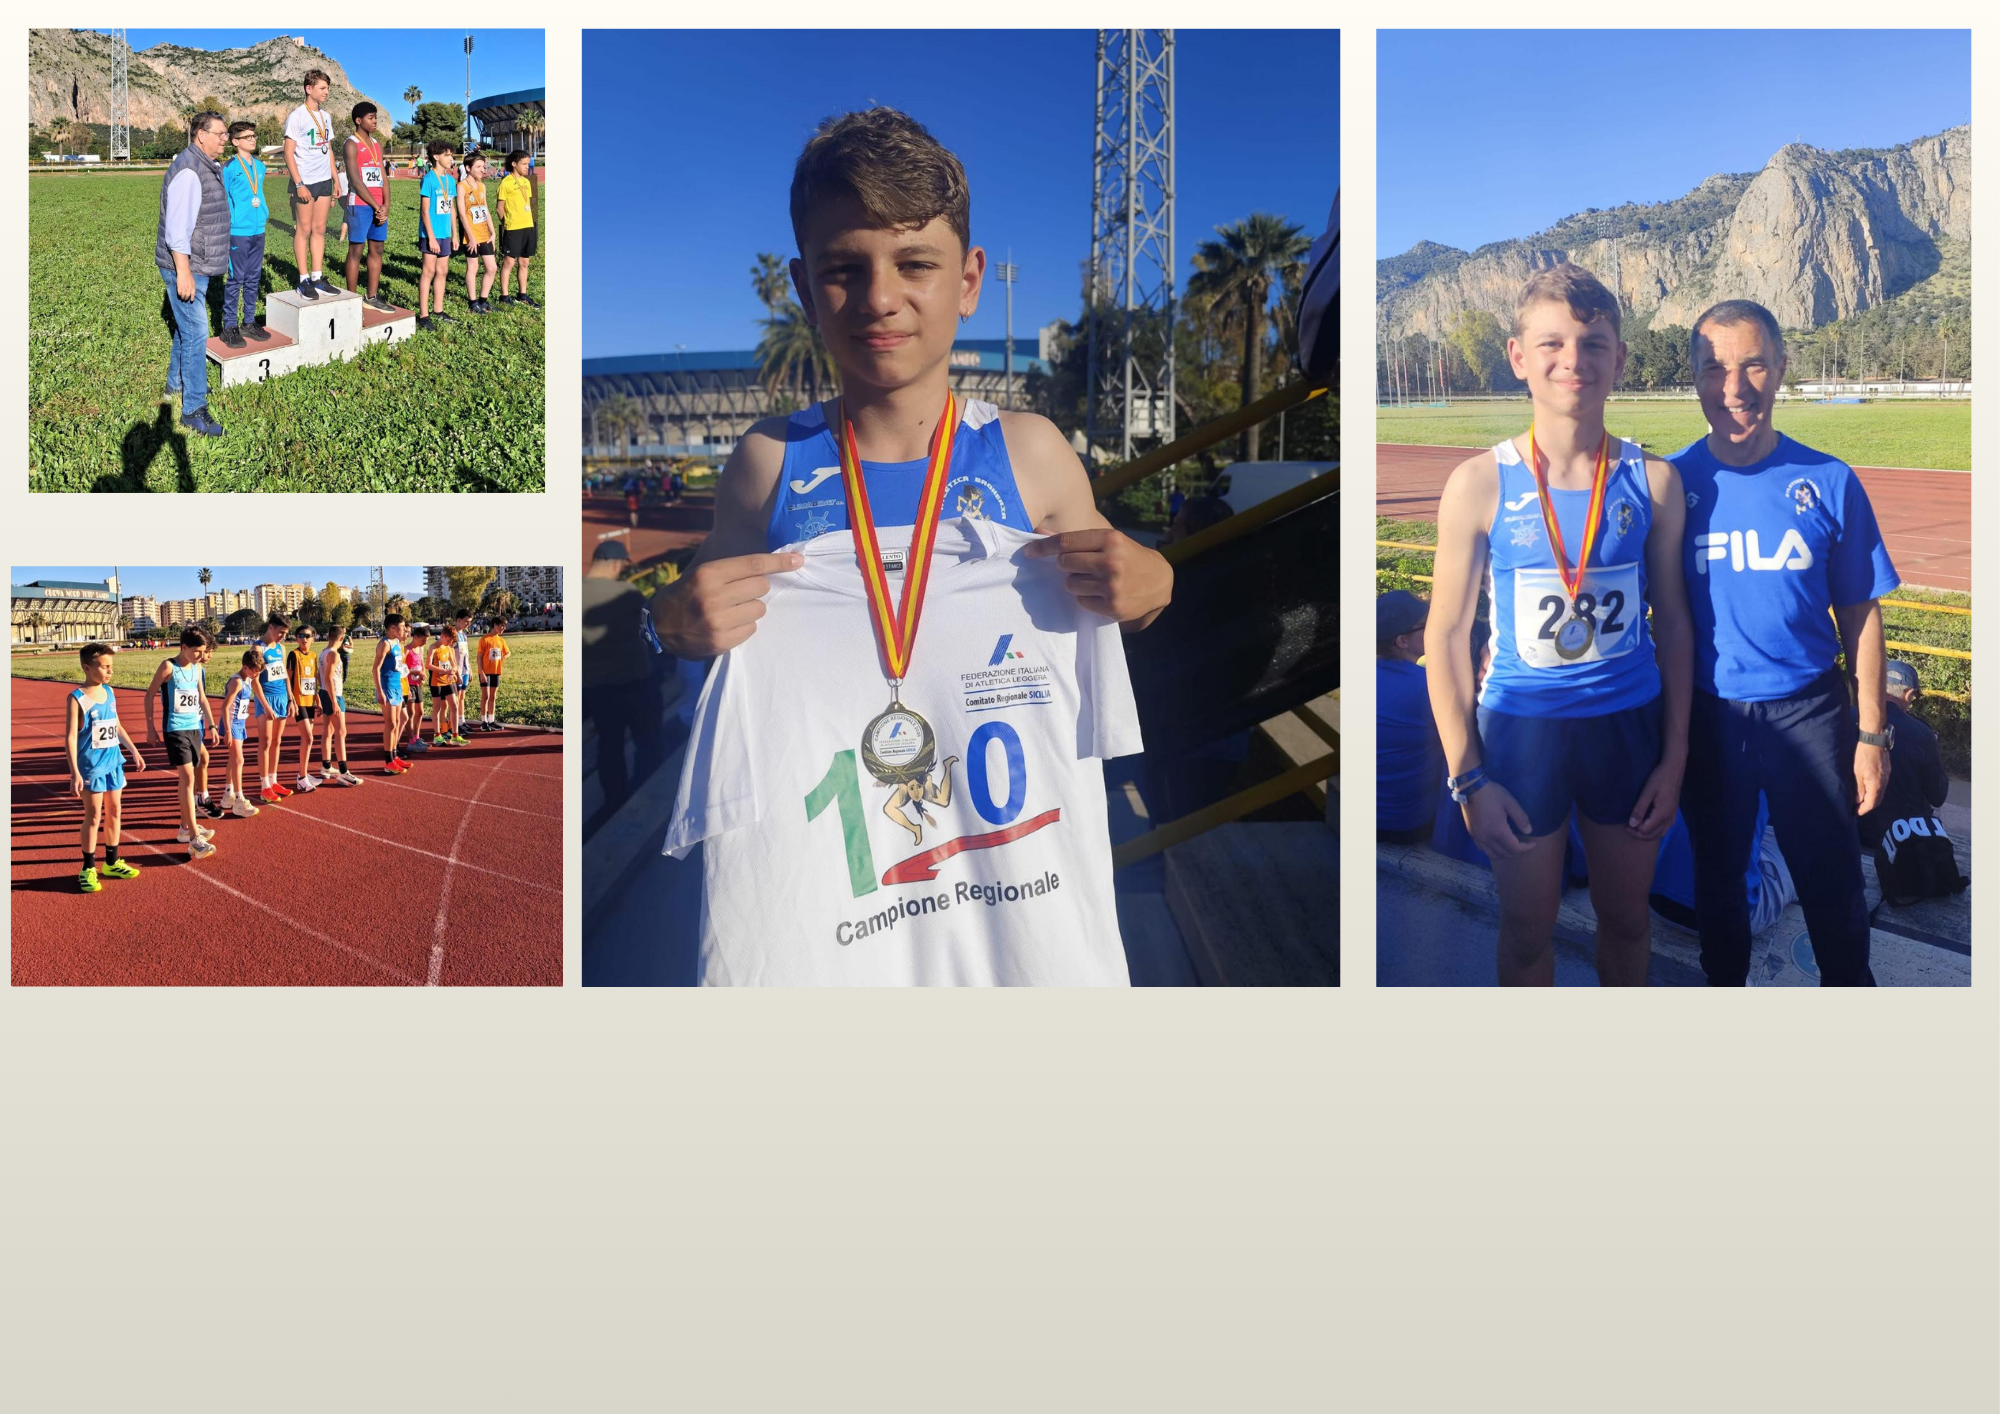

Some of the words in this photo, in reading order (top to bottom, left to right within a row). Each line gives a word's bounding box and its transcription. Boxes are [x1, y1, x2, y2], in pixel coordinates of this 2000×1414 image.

[328, 318, 335, 340] 1
[258, 358, 271, 382] 3
[1694, 528, 1814, 575] FILA
[1538, 589, 1626, 640] 282
[960, 668, 1016, 681] FEDERAZIONE
[1017, 665, 1050, 675] ITALIANA
[974, 677, 1012, 688] ATLETICA
[1012, 674, 1048, 683] LEGGERA
[965, 696, 996, 707] Comitato
[996, 691, 1028, 704] Regionale
[1029, 689, 1052, 699] SICILIA
[835, 891, 950, 947] Campione
[954, 870, 1060, 907] Regionale
